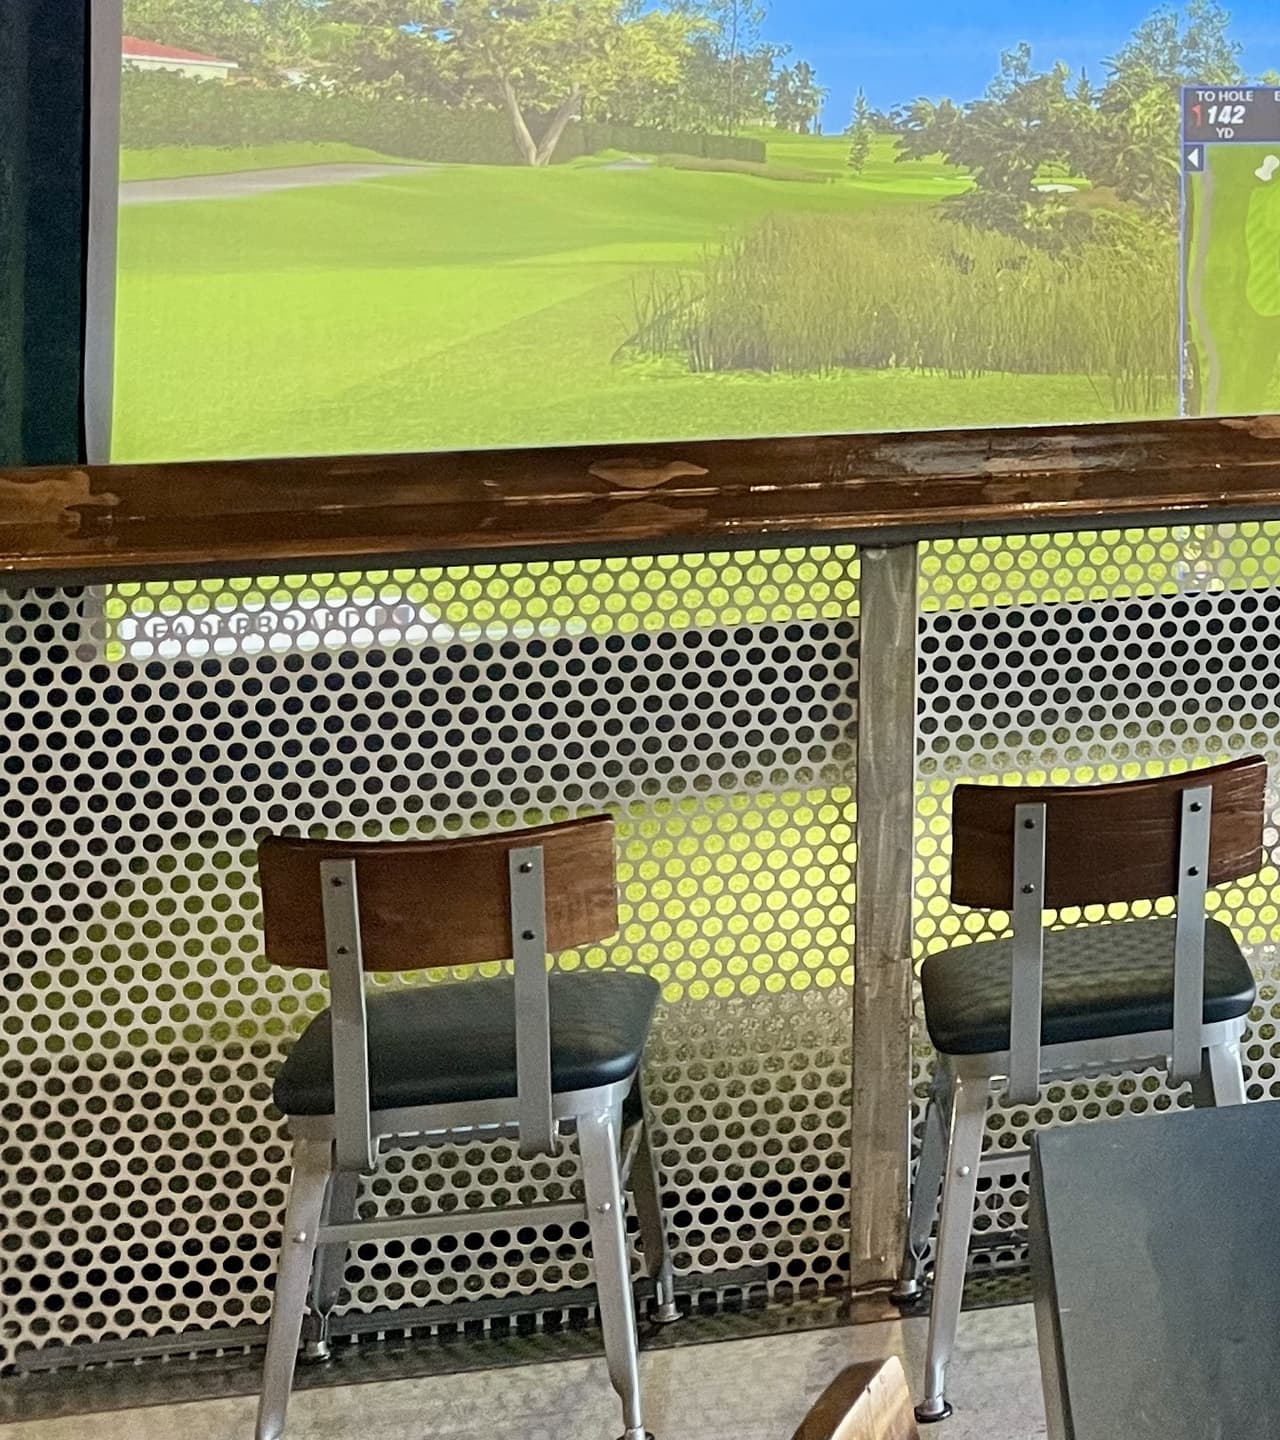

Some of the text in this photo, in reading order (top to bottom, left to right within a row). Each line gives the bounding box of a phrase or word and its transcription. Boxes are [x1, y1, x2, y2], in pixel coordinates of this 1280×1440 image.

[1196, 91, 1254, 102] TO HOLE
[1207, 105, 1246, 125] 142
[1216, 127, 1234, 139] YD
